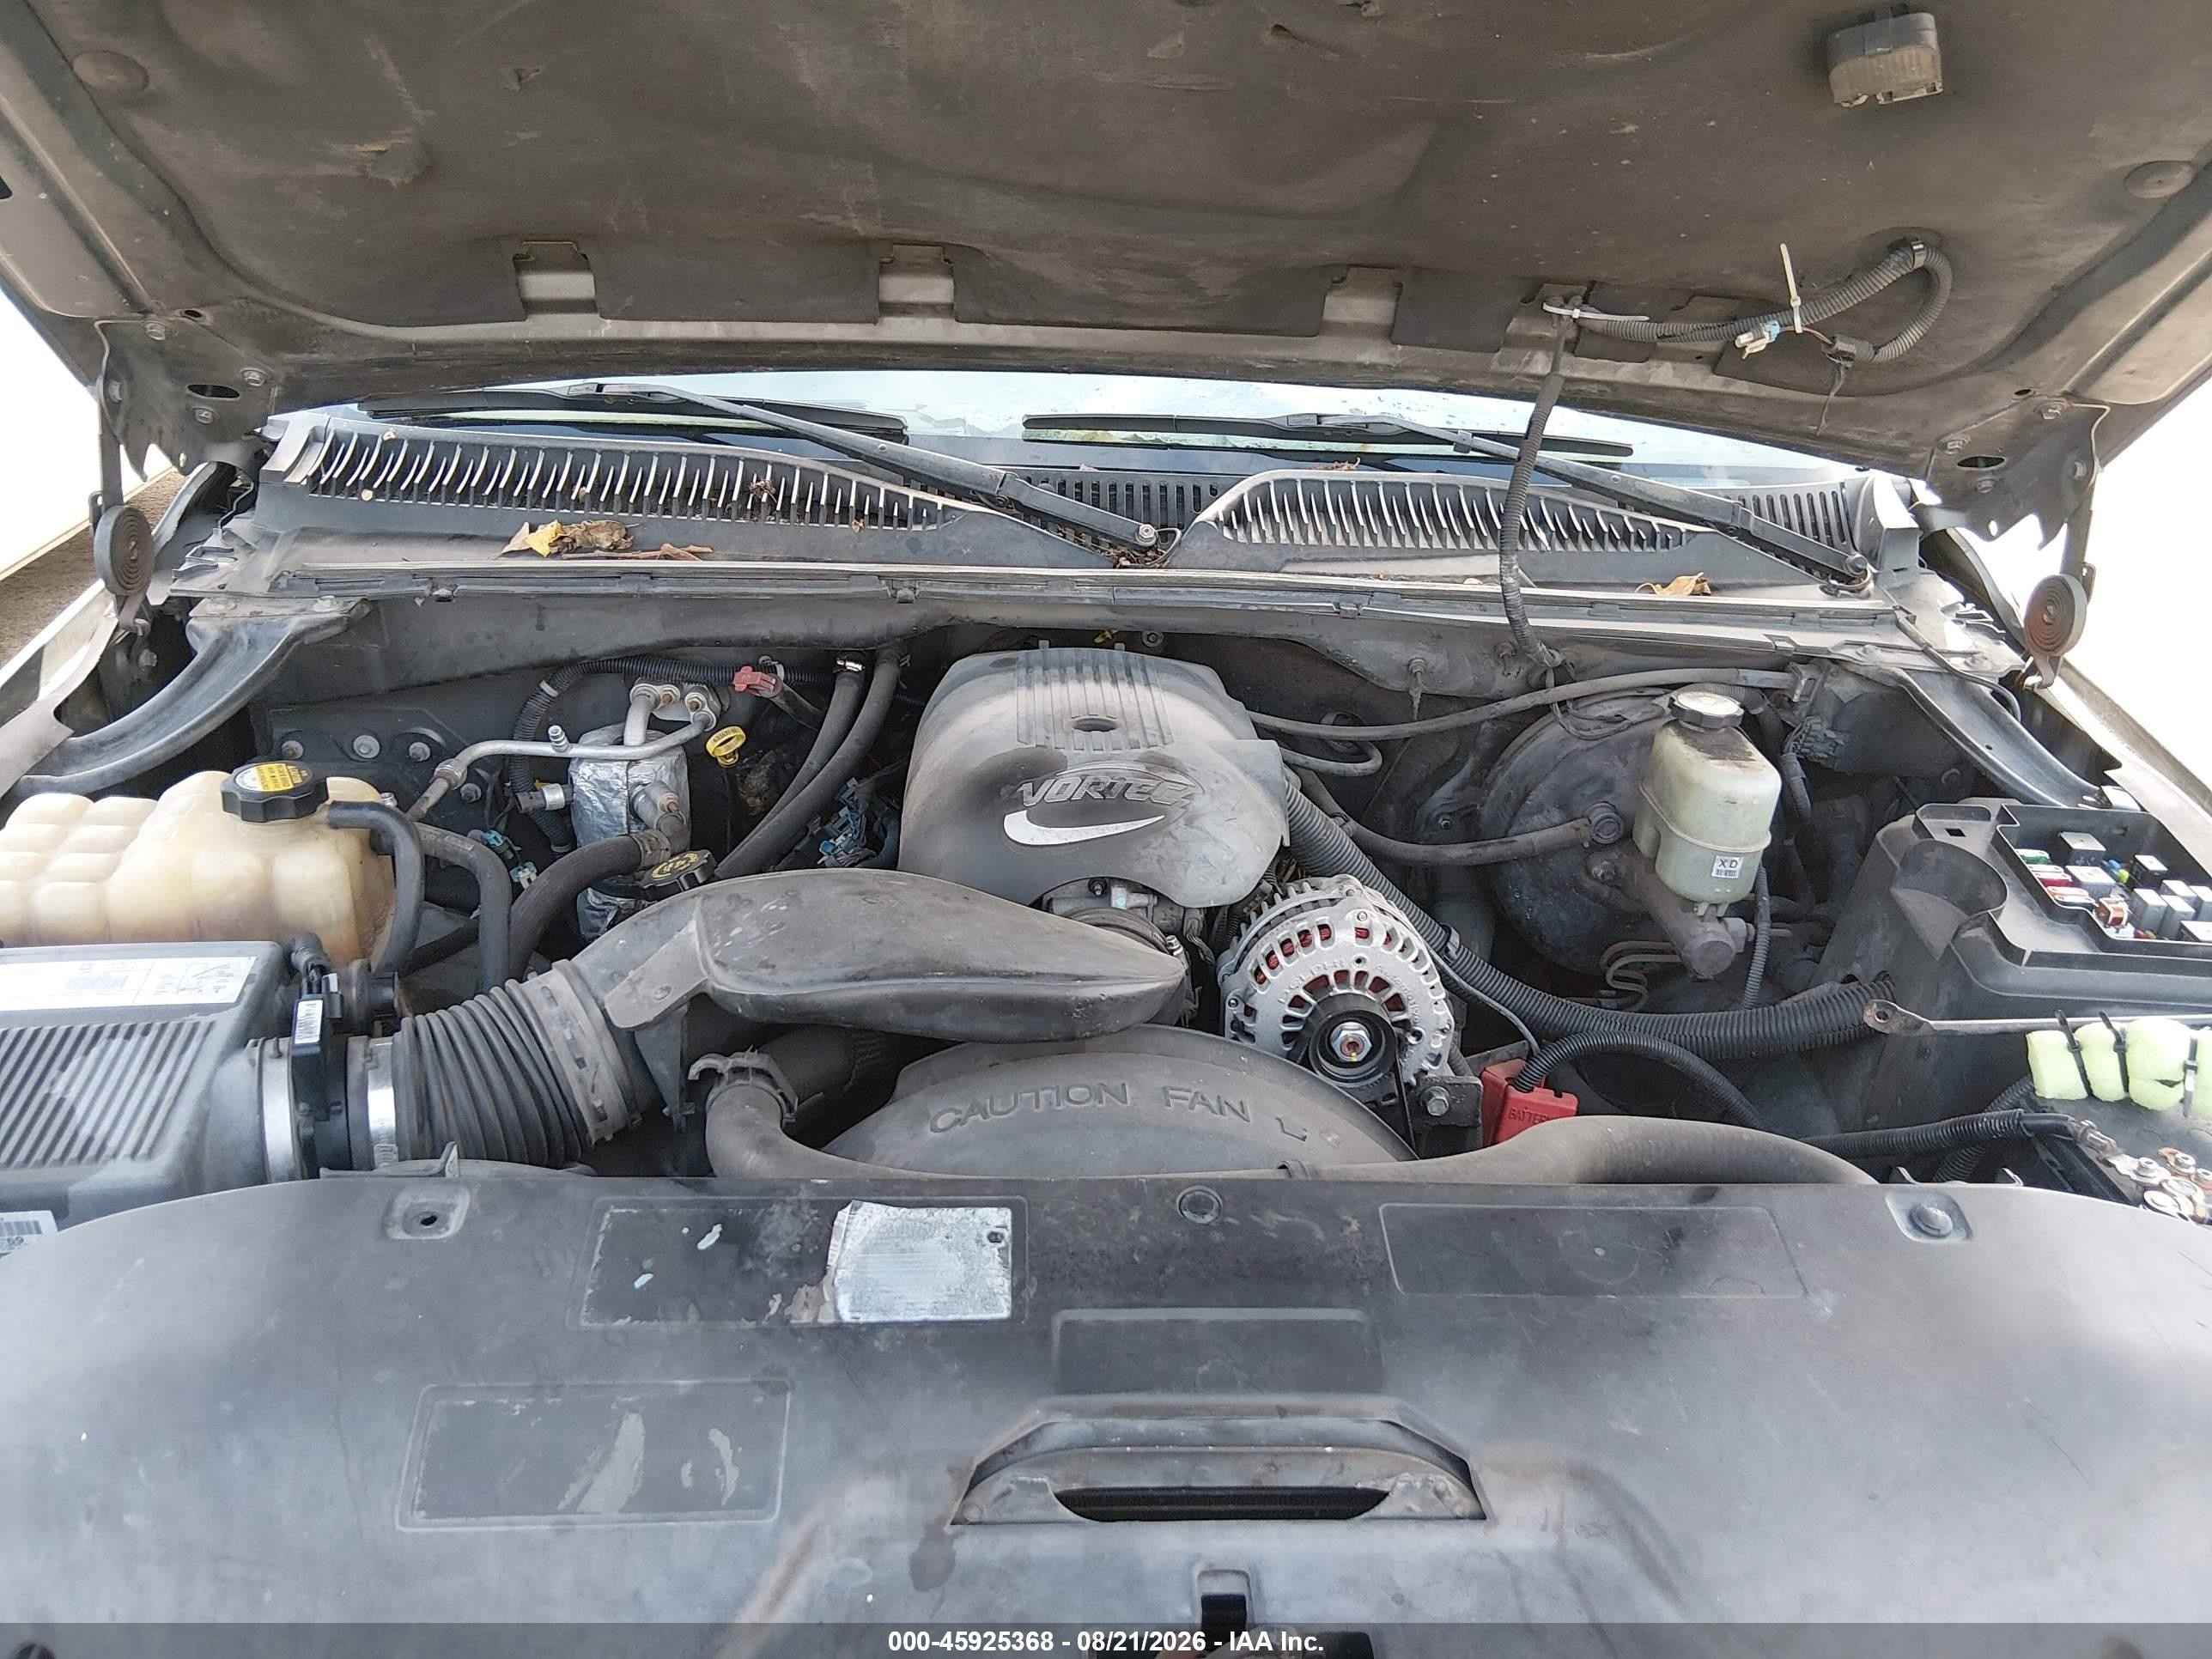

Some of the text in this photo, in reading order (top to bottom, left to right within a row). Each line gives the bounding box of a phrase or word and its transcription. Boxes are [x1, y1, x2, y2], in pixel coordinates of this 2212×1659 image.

[1017, 774, 1194, 807] VORTEC
[928, 1081, 1253, 1135] CAUTION FAN
